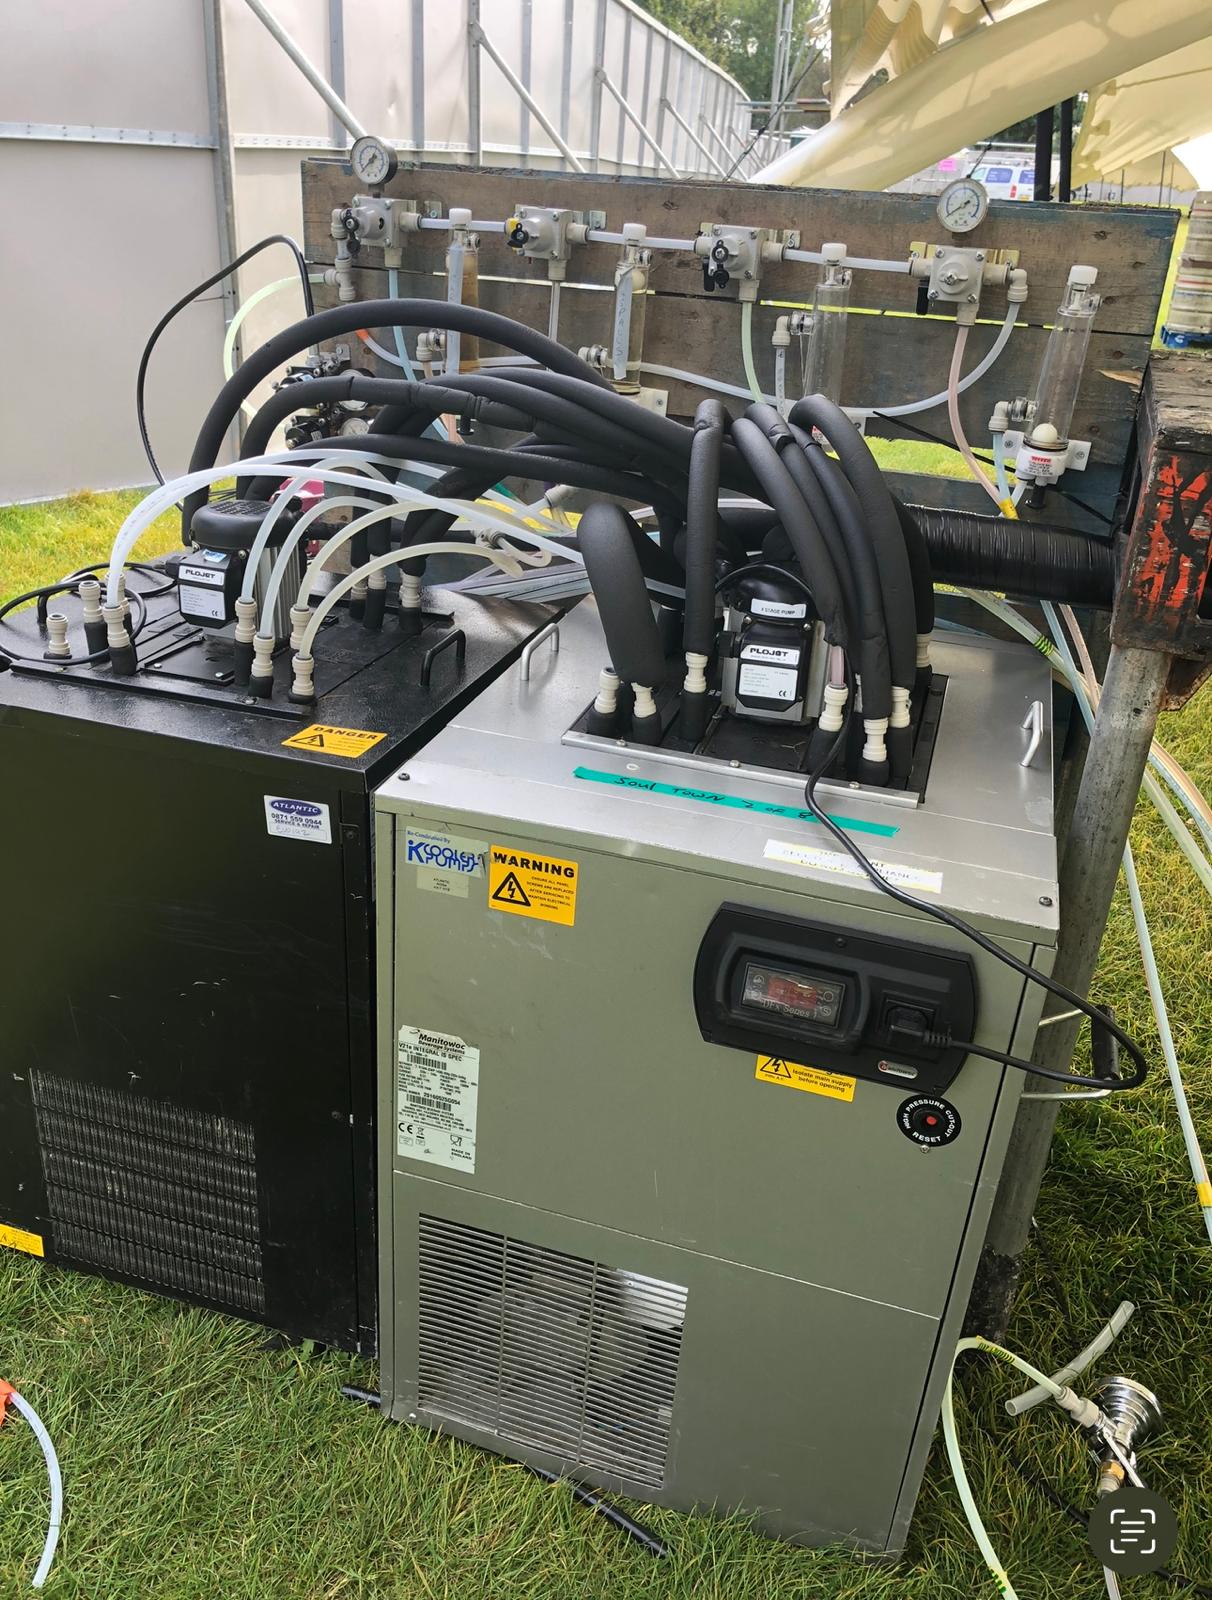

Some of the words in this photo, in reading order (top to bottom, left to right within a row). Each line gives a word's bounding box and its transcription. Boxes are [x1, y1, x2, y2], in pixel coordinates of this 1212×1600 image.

[313, 727, 378, 740] DANGER
[614, 777, 656, 790] Soul
[273, 802, 318, 813] ATLANTIC
[271, 812, 288, 820] 0871
[493, 852, 575, 878] WARNING
[418, 1040, 443, 1049] Beverage
[444, 1046, 465, 1054] Systems
[419, 1034, 465, 1049] Manitowoc
[413, 1045, 439, 1056] INTEGRAL
[448, 1053, 462, 1061] SPEC
[792, 1068, 813, 1078] Isolate
[815, 1074, 830, 1082] main
[831, 1078, 853, 1088] supply
[798, 1076, 818, 1085] before
[819, 1081, 845, 1092] opening
[905, 1099, 945, 1112] PRESSURE
[944, 1110, 955, 1137] CUT-OUT
[912, 1131, 941, 1142] RESET
